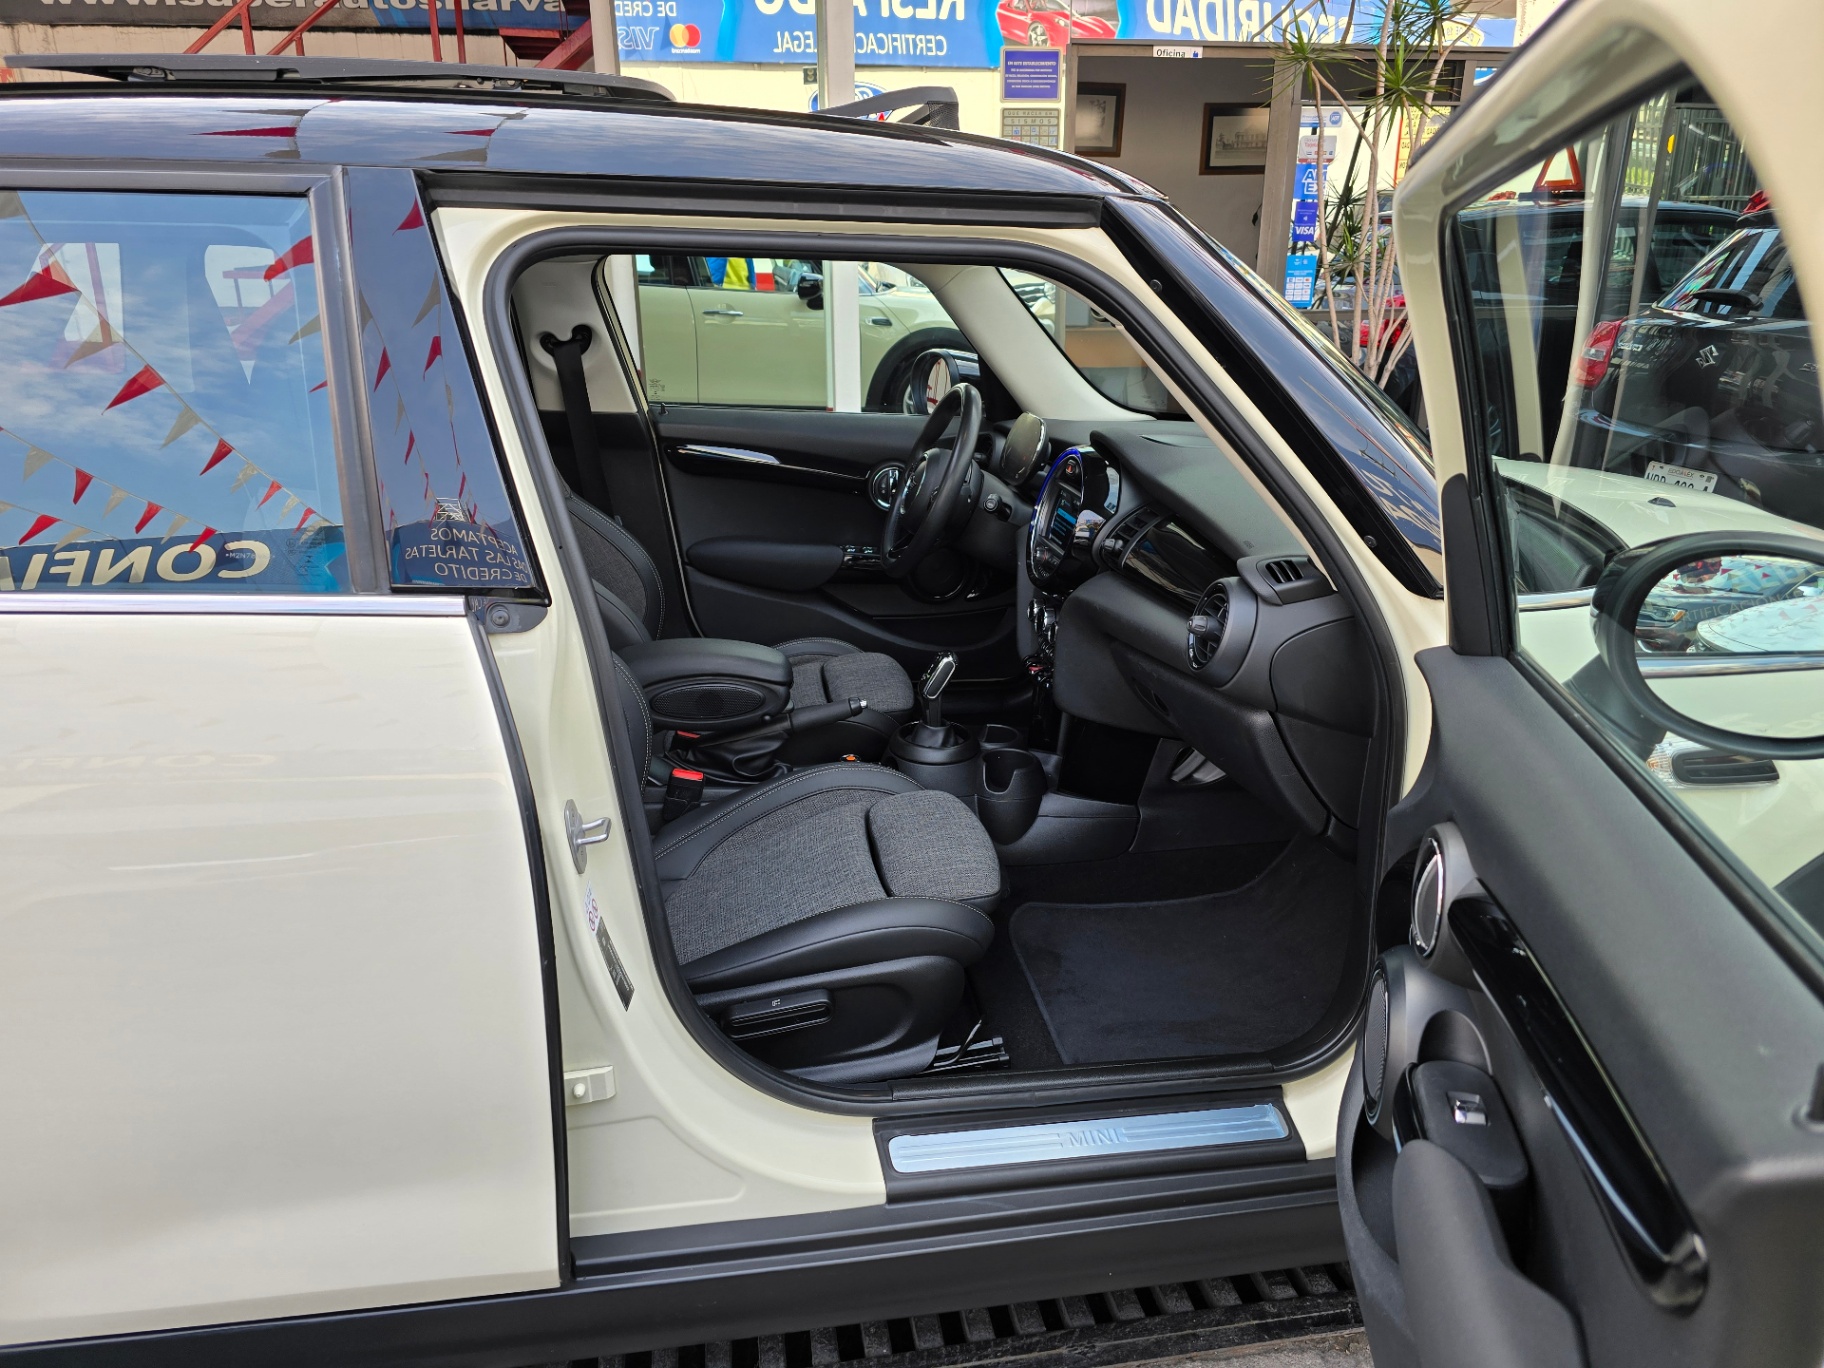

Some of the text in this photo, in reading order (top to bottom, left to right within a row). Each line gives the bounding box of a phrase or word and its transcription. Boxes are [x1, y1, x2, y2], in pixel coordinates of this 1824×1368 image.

[1156, 48, 1186, 58] Oficina
[1294, 226, 1315, 235] VISA
[1067, 1128, 1122, 1148] MINI
